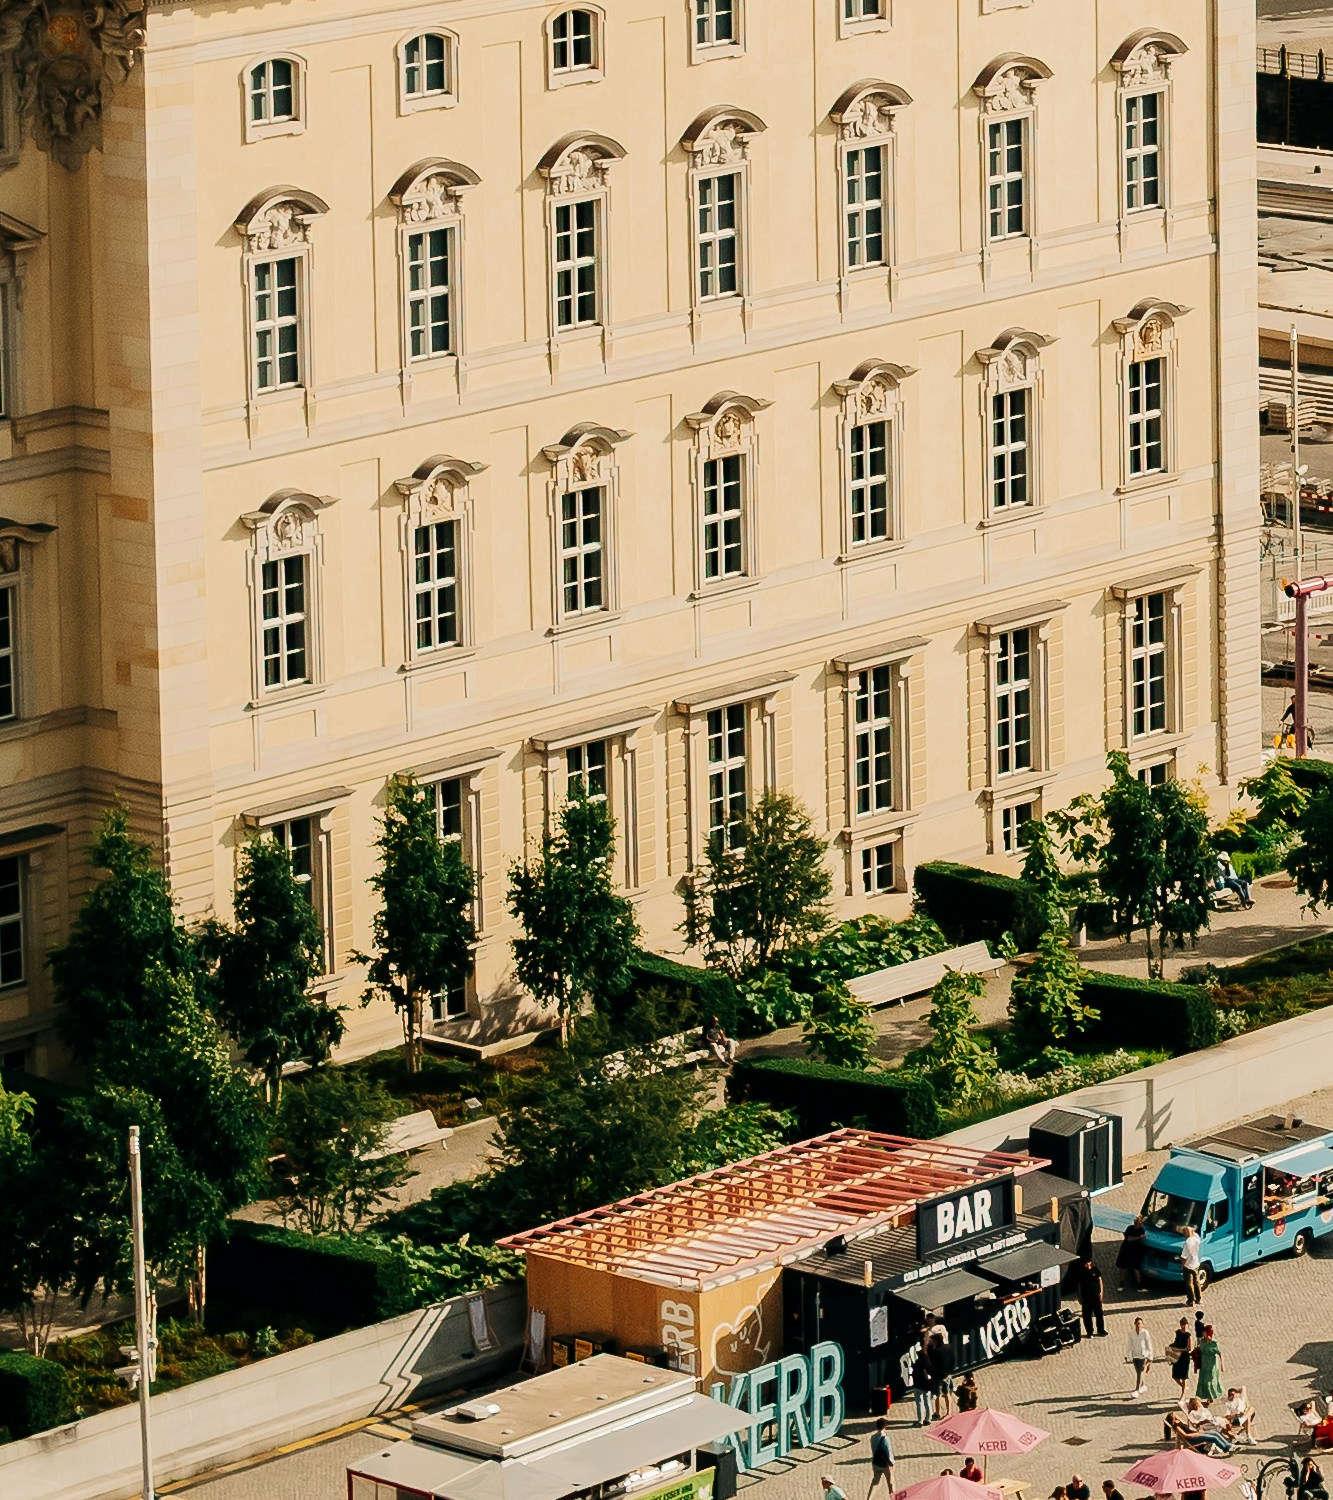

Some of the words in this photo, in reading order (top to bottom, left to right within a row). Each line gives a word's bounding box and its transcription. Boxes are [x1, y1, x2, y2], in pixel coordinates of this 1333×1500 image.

[936, 1189, 993, 1244] BAR
[660, 1299, 696, 1374] ERB
[979, 1298, 1032, 1360] KERB
[711, 1340, 846, 1474] KERB
[978, 1440, 1008, 1452] KERB
[1176, 1476, 1206, 1490] KERB
